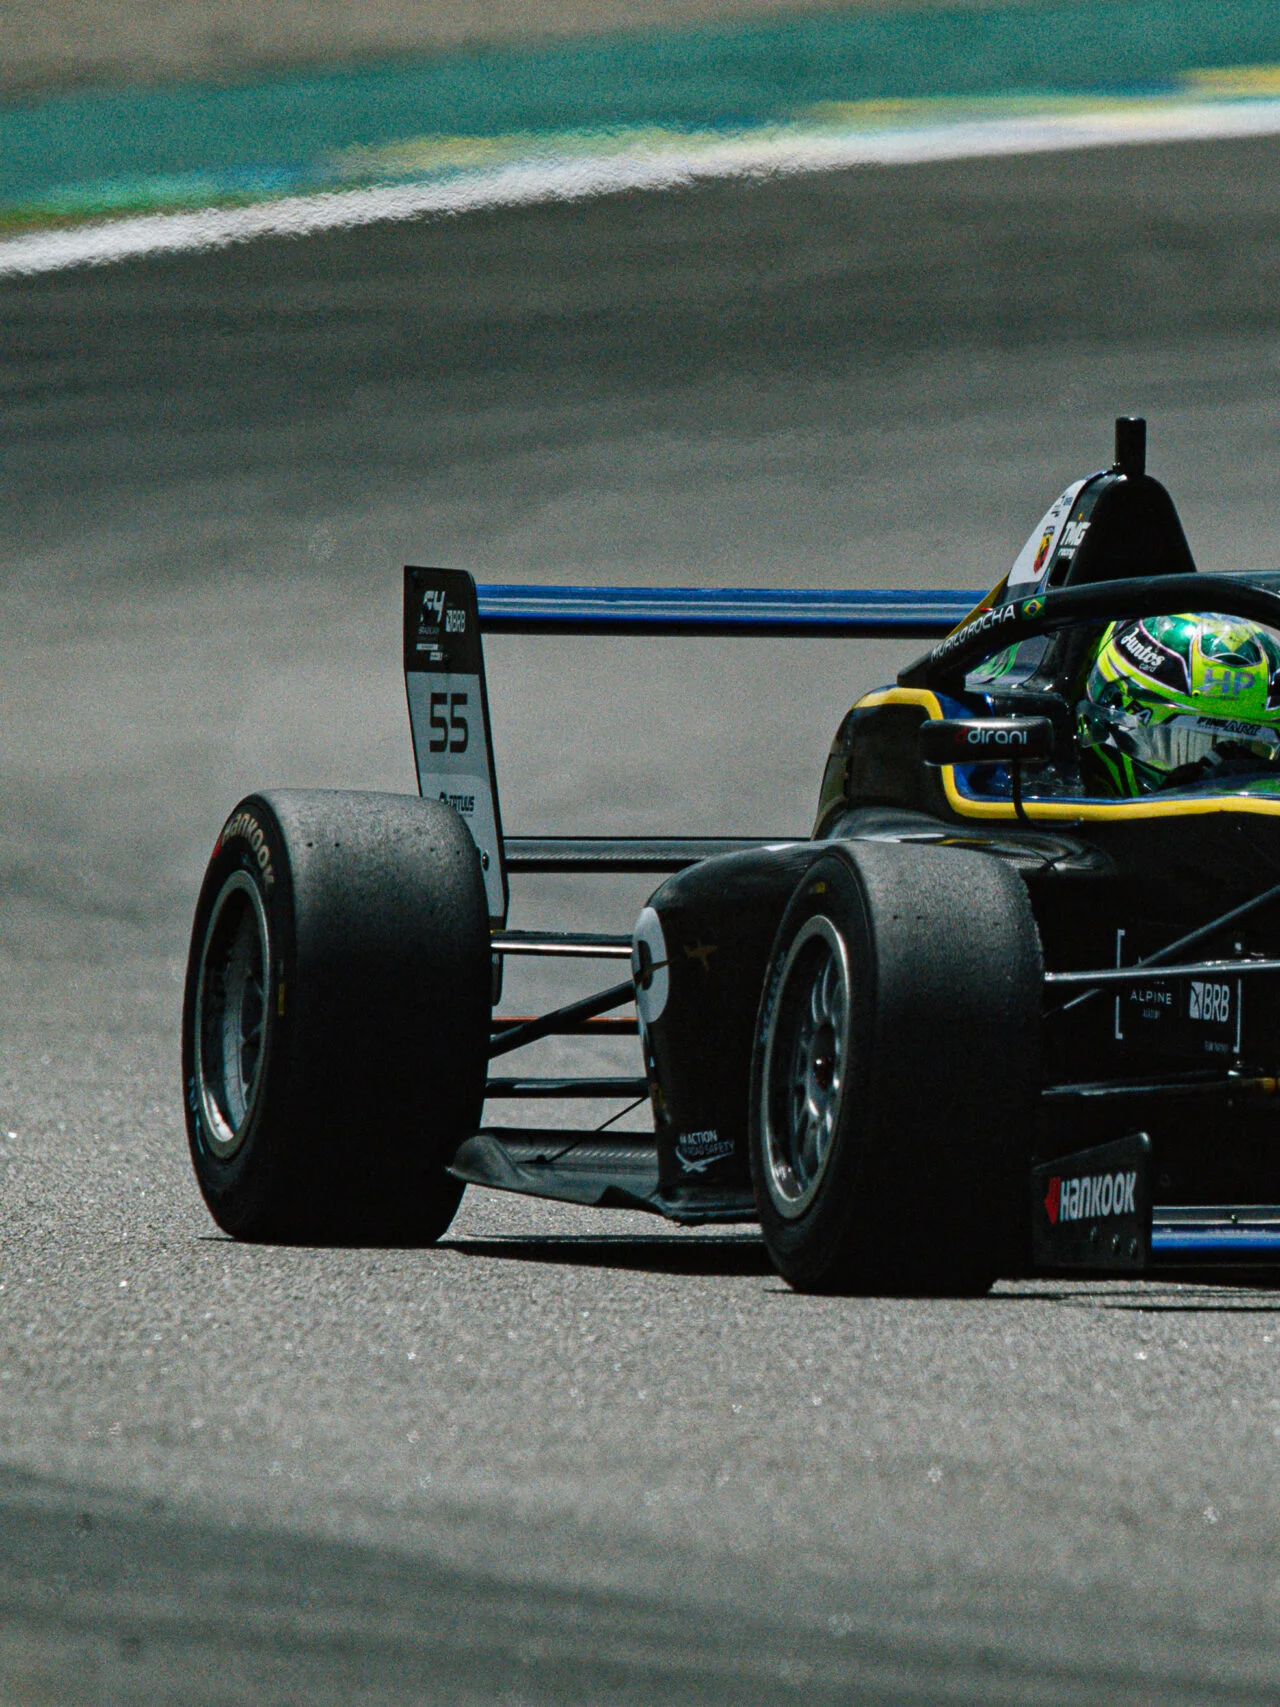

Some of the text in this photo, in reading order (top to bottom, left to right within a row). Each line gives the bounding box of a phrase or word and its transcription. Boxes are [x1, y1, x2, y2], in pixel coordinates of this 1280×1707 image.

[429, 692, 468, 753] 55
[1130, 989, 1173, 1005] ALPINE
[1203, 982, 1230, 1022] BRB
